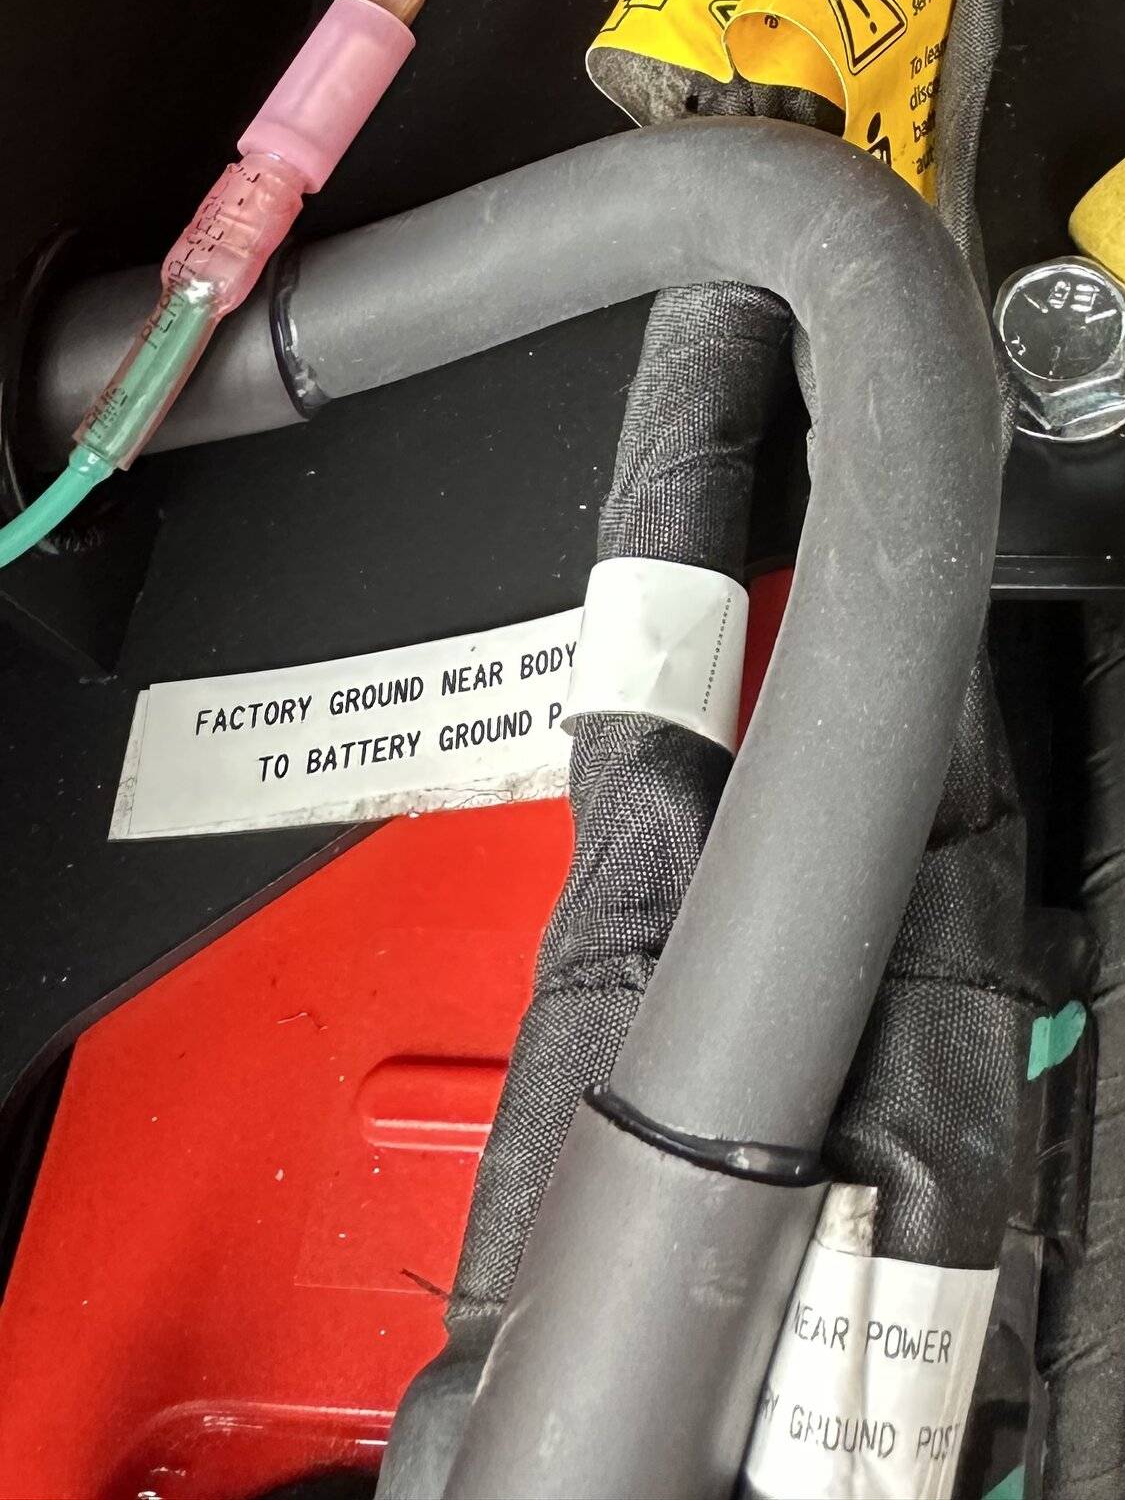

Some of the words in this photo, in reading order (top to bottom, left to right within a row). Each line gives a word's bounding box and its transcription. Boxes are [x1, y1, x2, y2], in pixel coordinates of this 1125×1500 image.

[909, 55, 923, 80] To
[195, 695, 313, 736] FACTORY
[329, 676, 424, 716] GROUND
[441, 661, 504, 696] NEAR
[520, 641, 577, 680] BODY
[259, 754, 290, 783] TO
[306, 730, 421, 775] BATTERY
[438, 709, 532, 751] GROUND
[864, 1320, 953, 1364] POWER
[789, 1404, 897, 1460] GROUND
